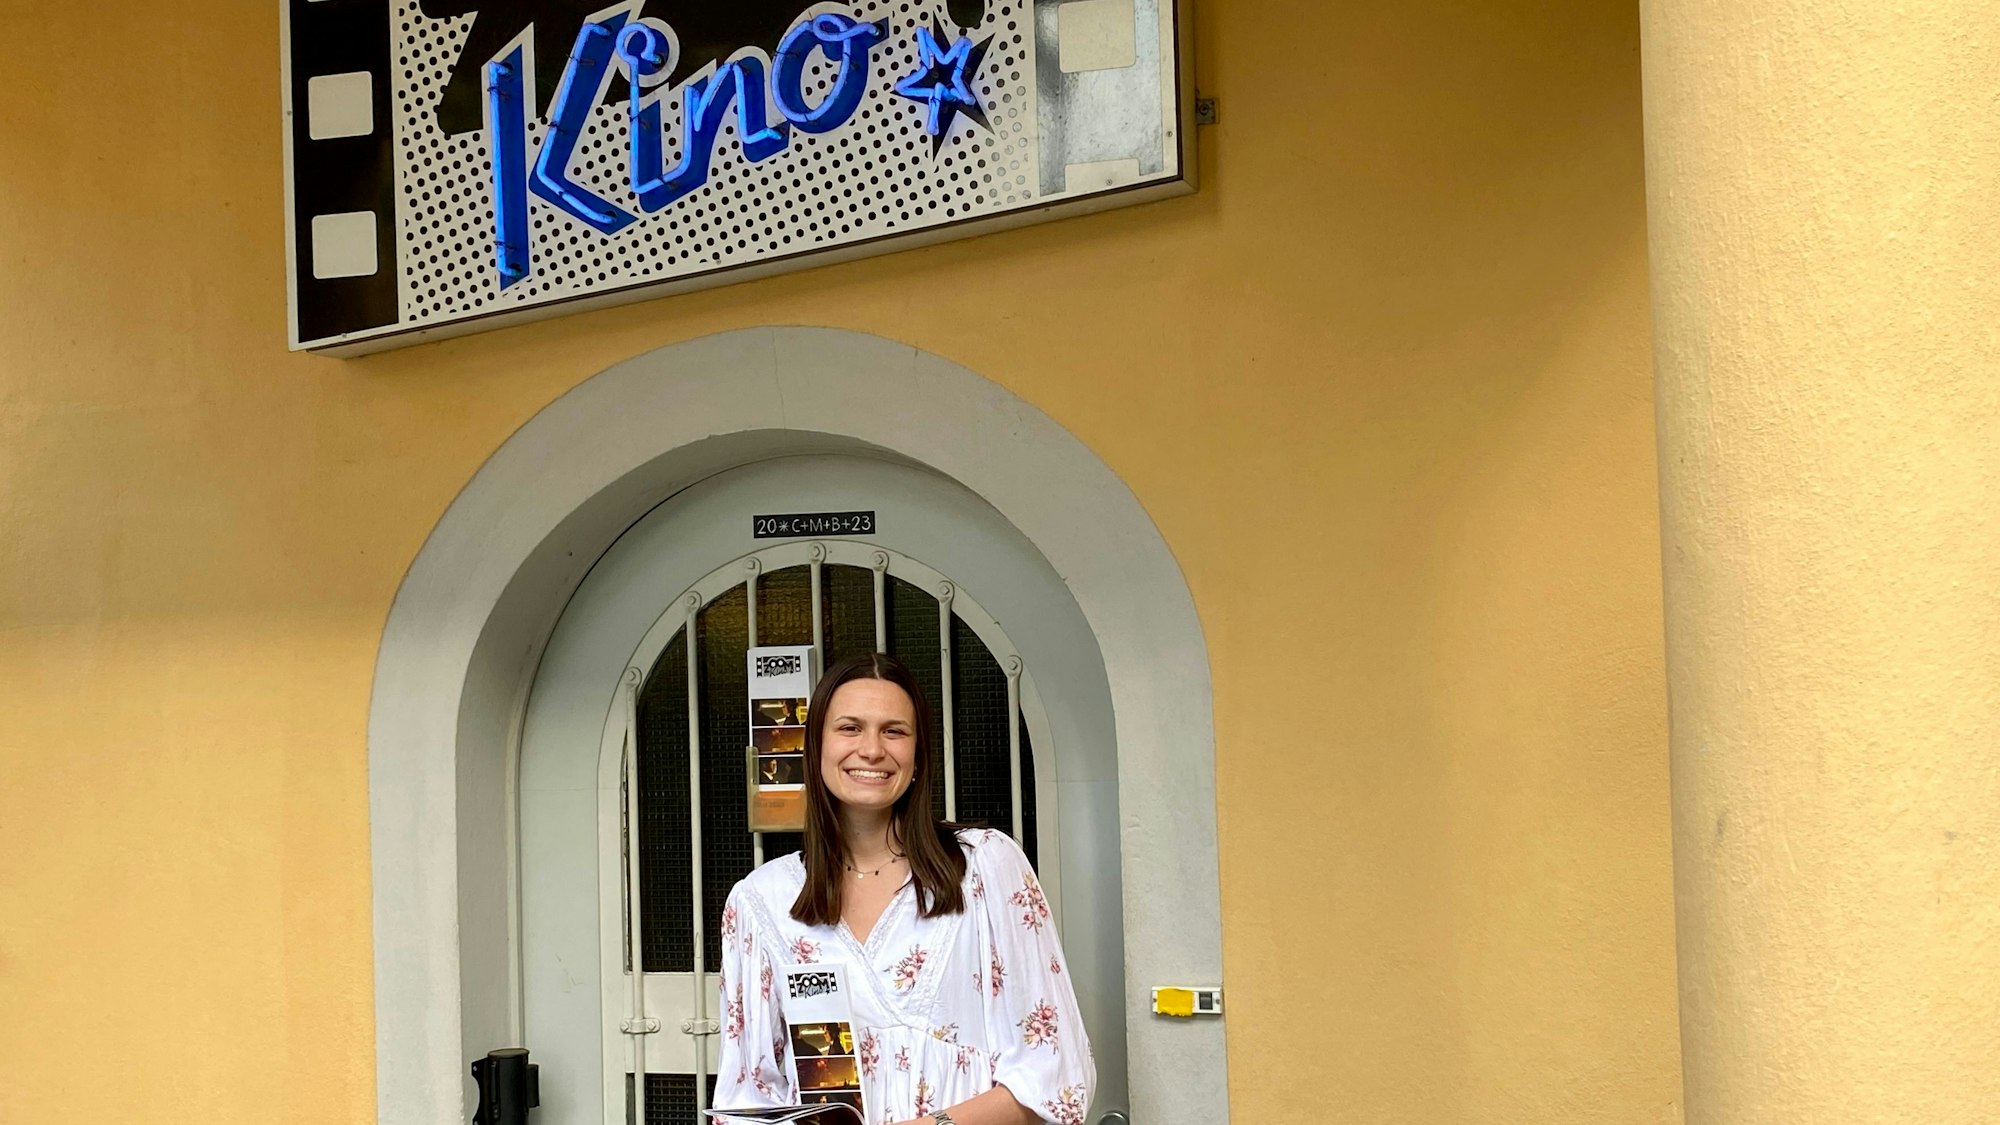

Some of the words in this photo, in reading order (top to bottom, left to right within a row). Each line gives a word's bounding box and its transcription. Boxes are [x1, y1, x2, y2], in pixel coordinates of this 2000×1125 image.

[488, 9, 889, 291] Kino
[764, 659, 794, 673] ZOOM
[797, 977, 830, 993] ZOOM
